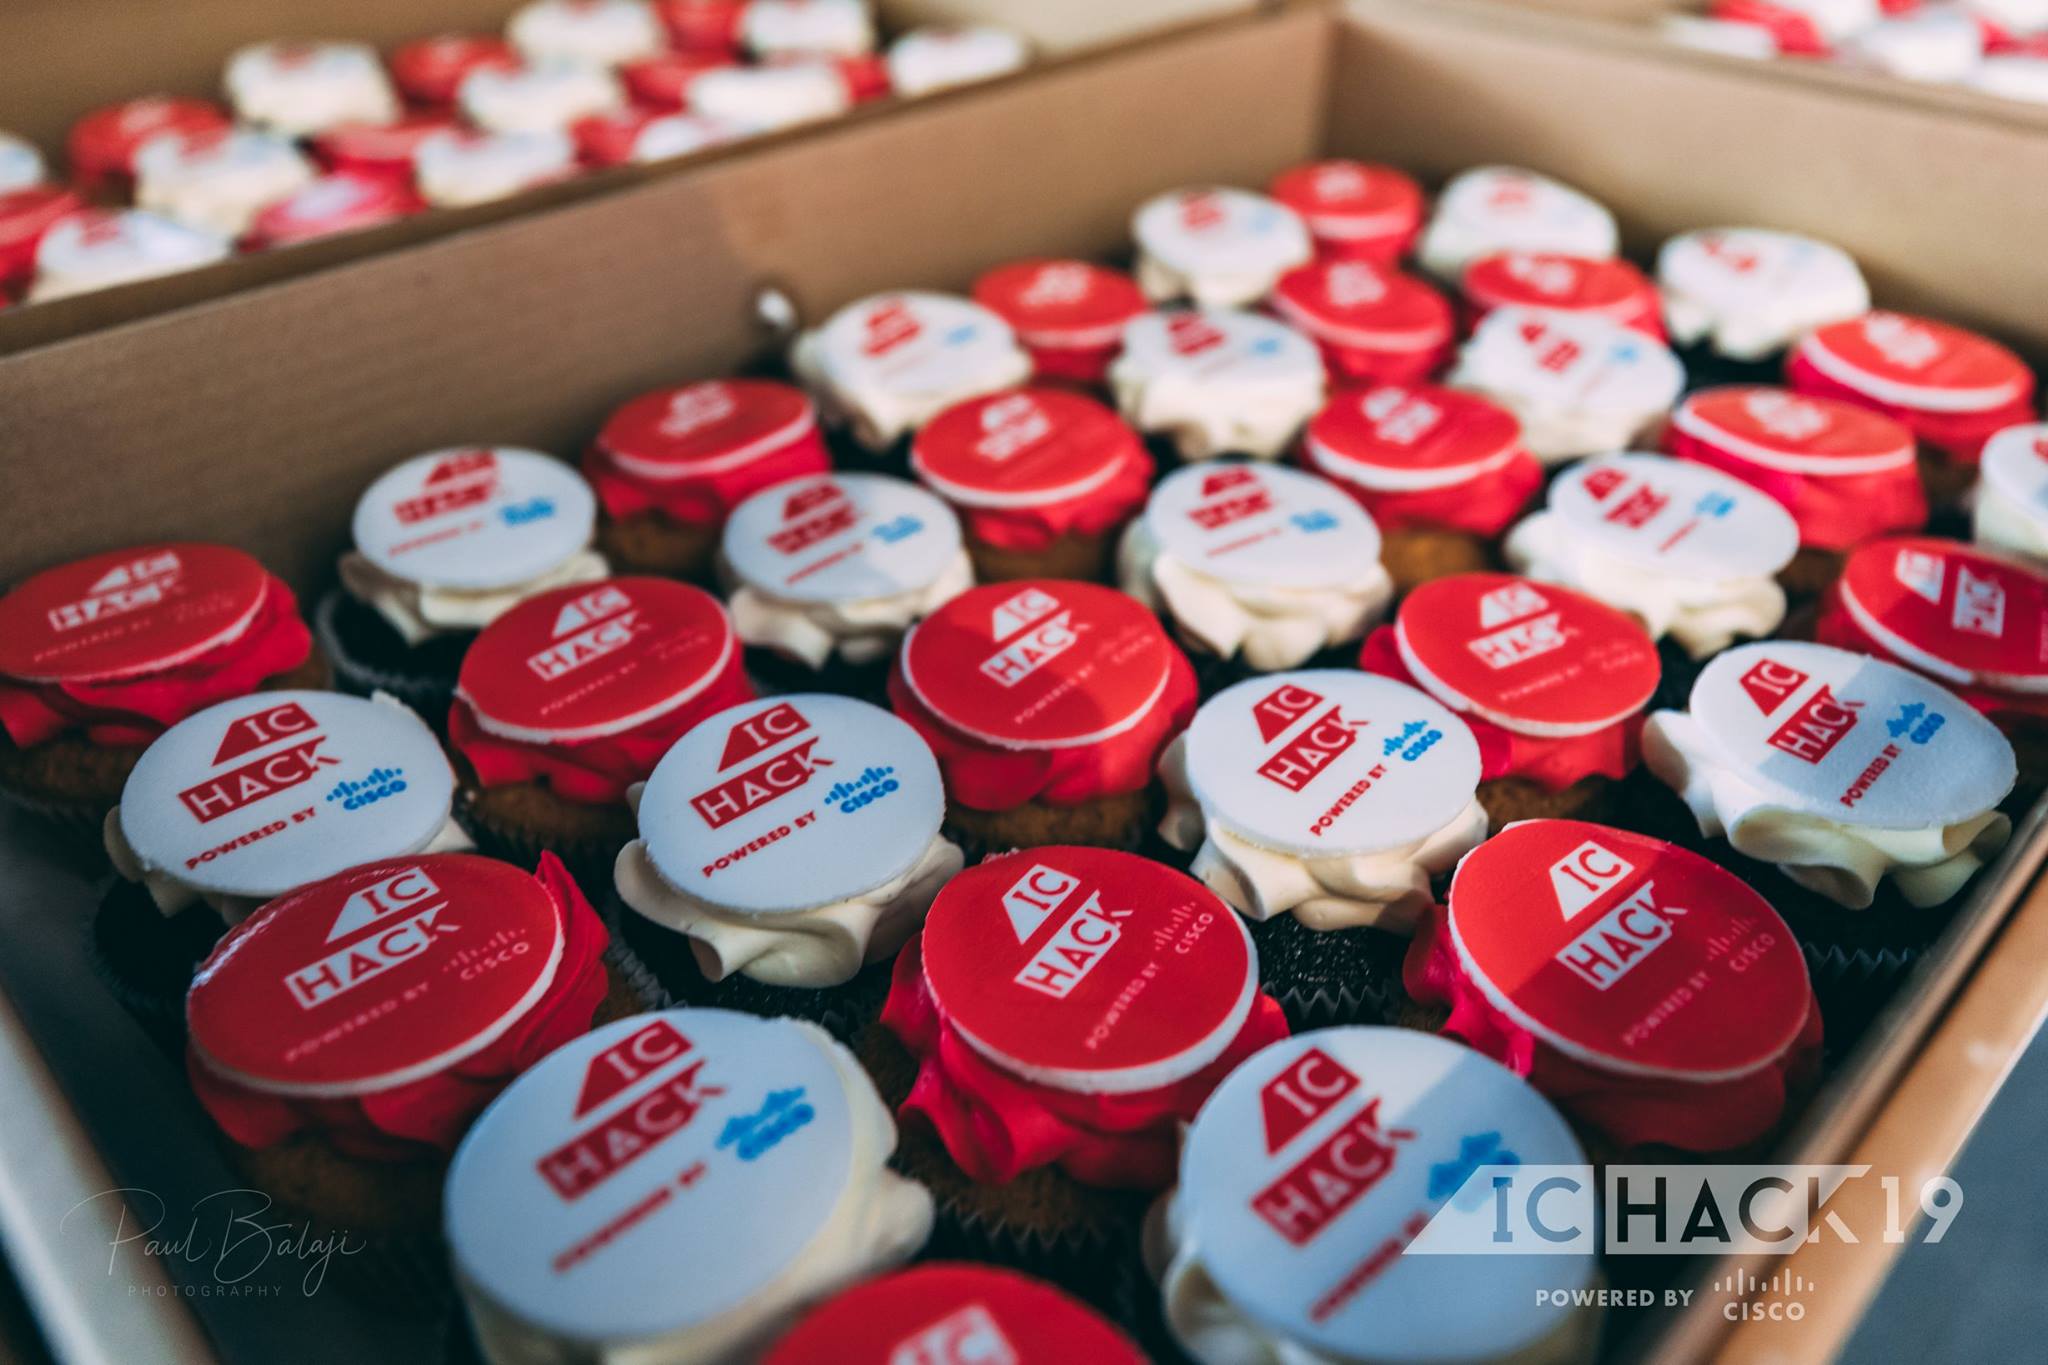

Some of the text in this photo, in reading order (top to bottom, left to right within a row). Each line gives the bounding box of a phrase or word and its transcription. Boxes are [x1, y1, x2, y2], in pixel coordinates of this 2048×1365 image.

[536, 615, 650, 678] HACK
[988, 612, 1091, 681] HACK
[1262, 688, 1314, 721] IC
[1747, 664, 1798, 696] IC
[742, 708, 799, 747] IC
[1265, 707, 1370, 787] HACK
[1776, 688, 1865, 758] HACK
[189, 738, 341, 817] HACK
[699, 739, 835, 823] HACK
[1309, 779, 1371, 836] POWERED
[1368, 763, 1388, 780] BY
[1839, 754, 1890, 808] POWERED
[185, 819, 287, 870] POWERED
[291, 806, 316, 824] BY
[702, 778, 900, 878] POWERED BY CISCO
[360, 873, 429, 916] IC
[1011, 870, 1070, 912] IC
[1560, 848, 1622, 892] IC
[293, 905, 461, 1002] HACK
[459, 941, 530, 982] CISCO
[1024, 893, 1134, 993] HACK
[1564, 884, 1688, 984] HACK
[1728, 931, 1776, 973] CISCO
[1083, 911, 1214, 1050] POWERED BY CISCO
[603, 1027, 680, 1081] IC
[1272, 1056, 1348, 1118] IC
[548, 1062, 727, 1188] HACK
[1262, 1101, 1417, 1238] HACK
